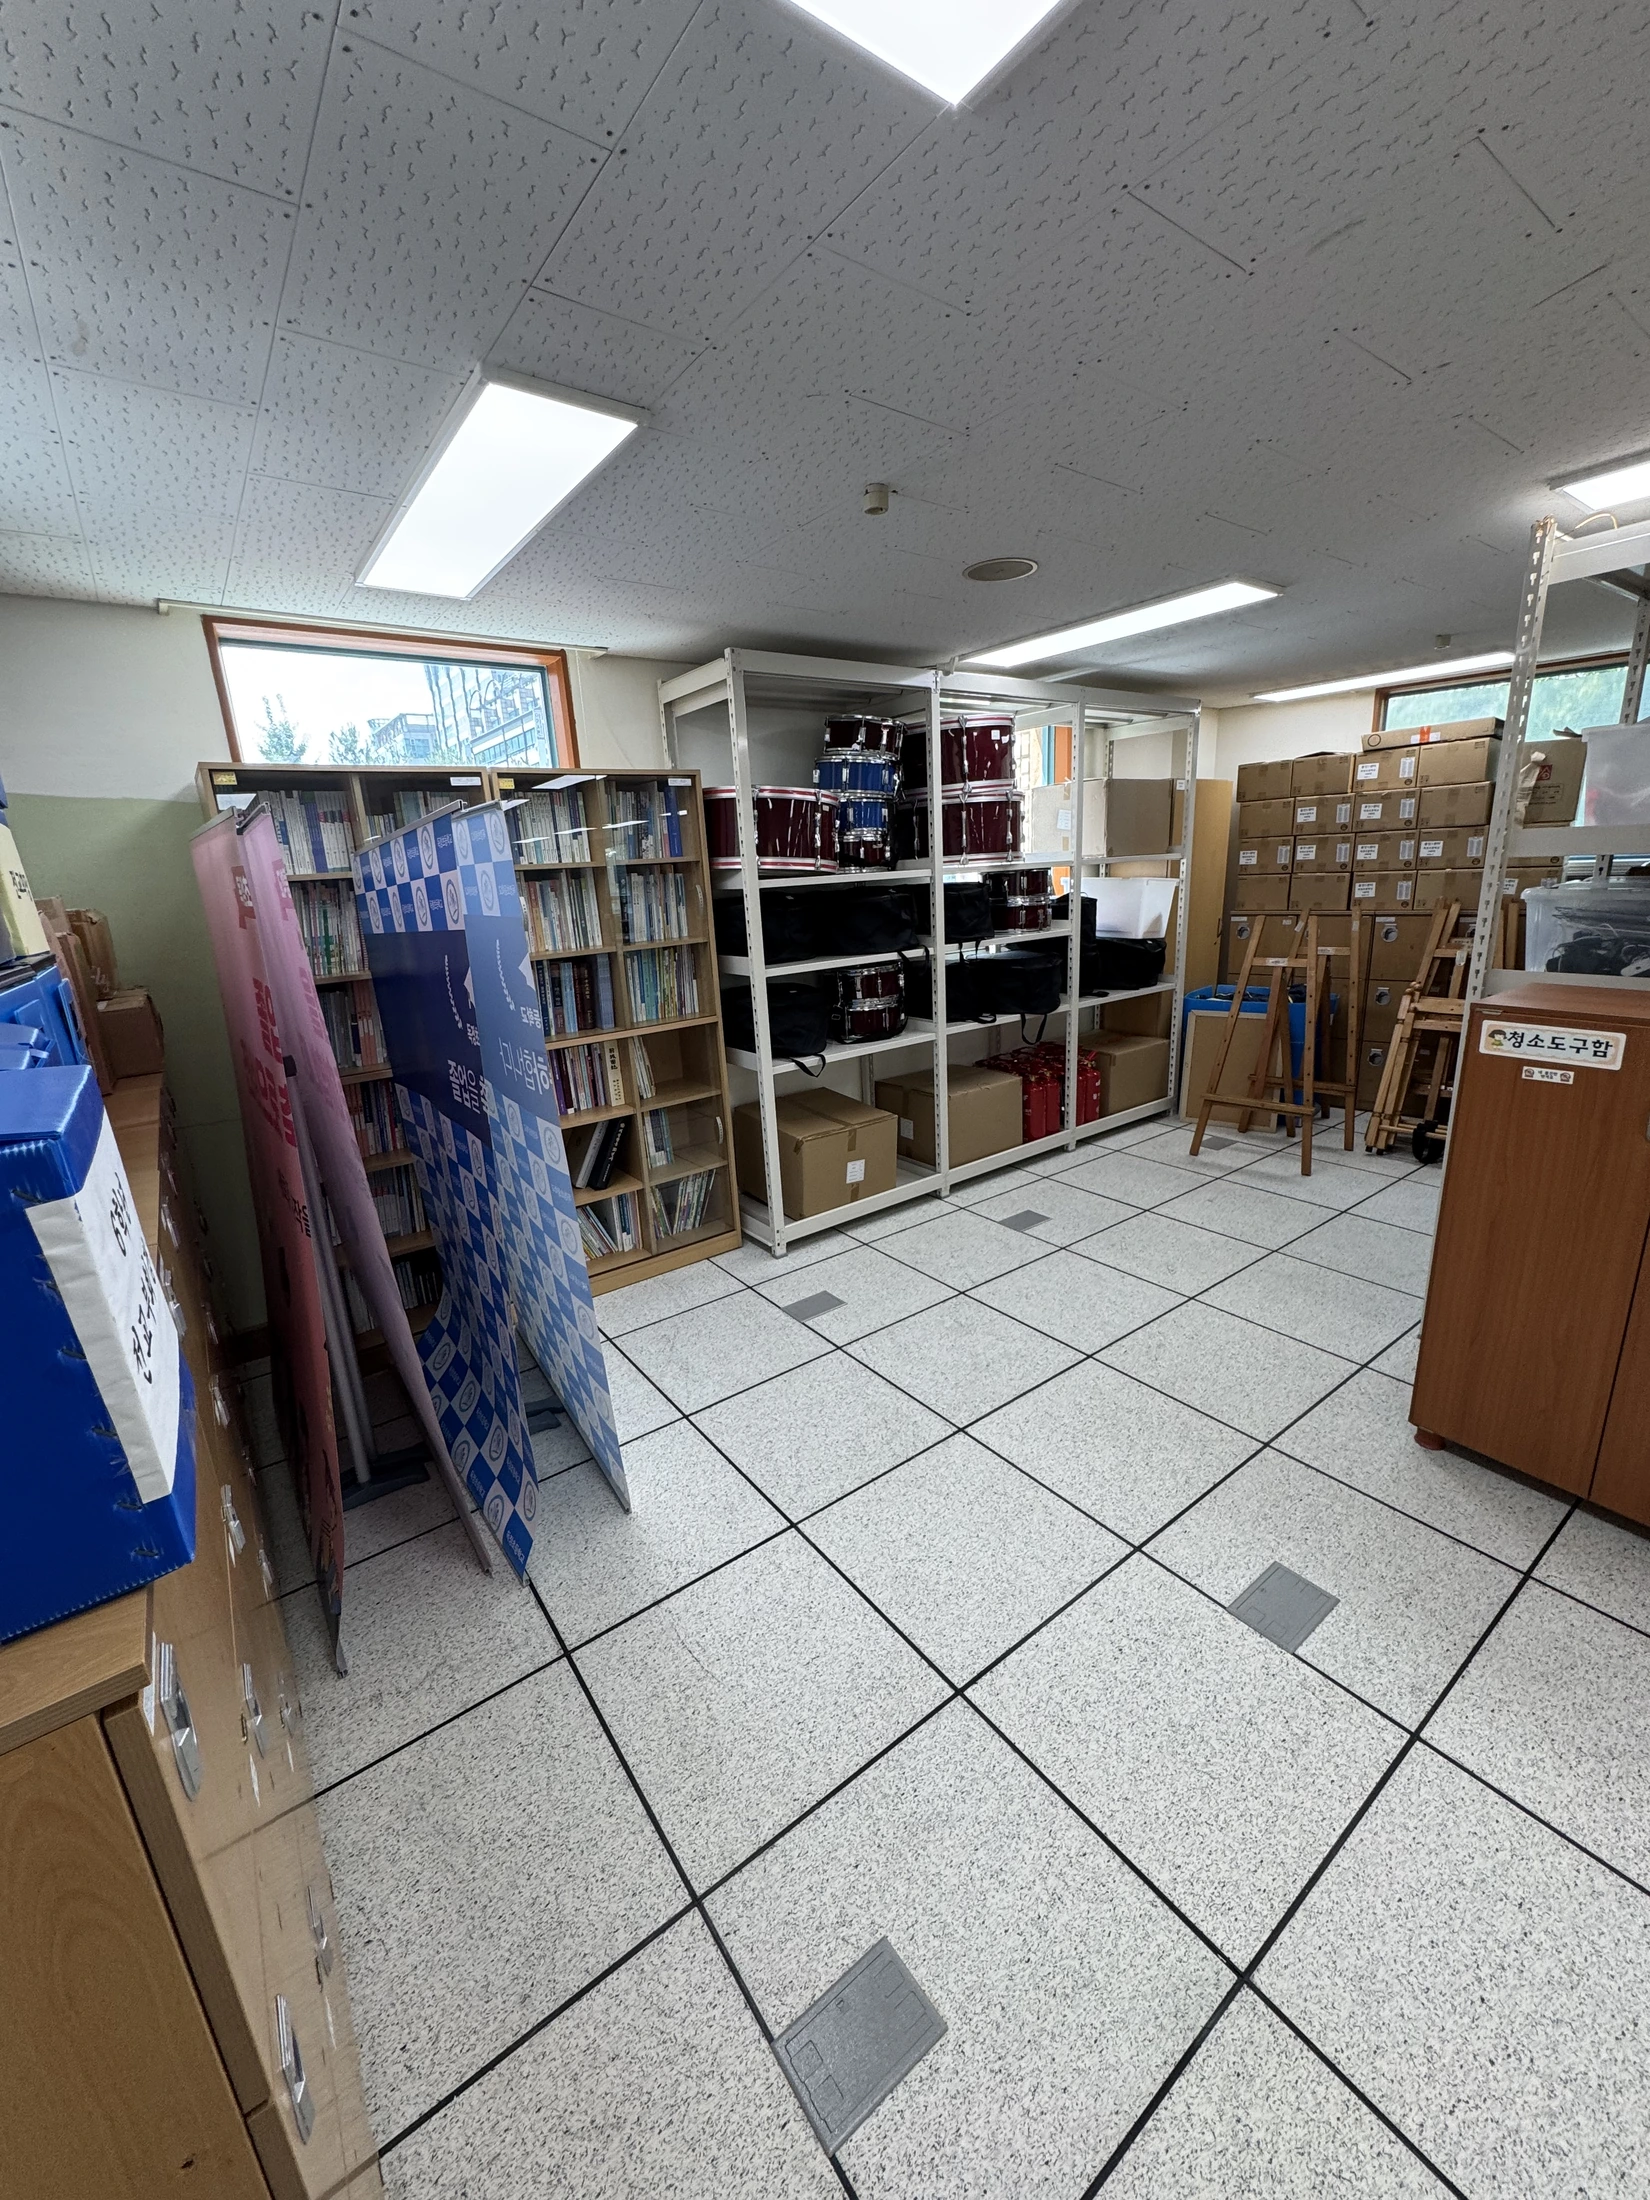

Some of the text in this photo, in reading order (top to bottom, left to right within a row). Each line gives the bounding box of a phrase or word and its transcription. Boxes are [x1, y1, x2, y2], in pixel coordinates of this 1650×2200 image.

[1507, 1031, 1613, 1058] 청소도구함
[447, 1059, 481, 1114] 졸업을
[110, 1172, 132, 1257] 6학년
